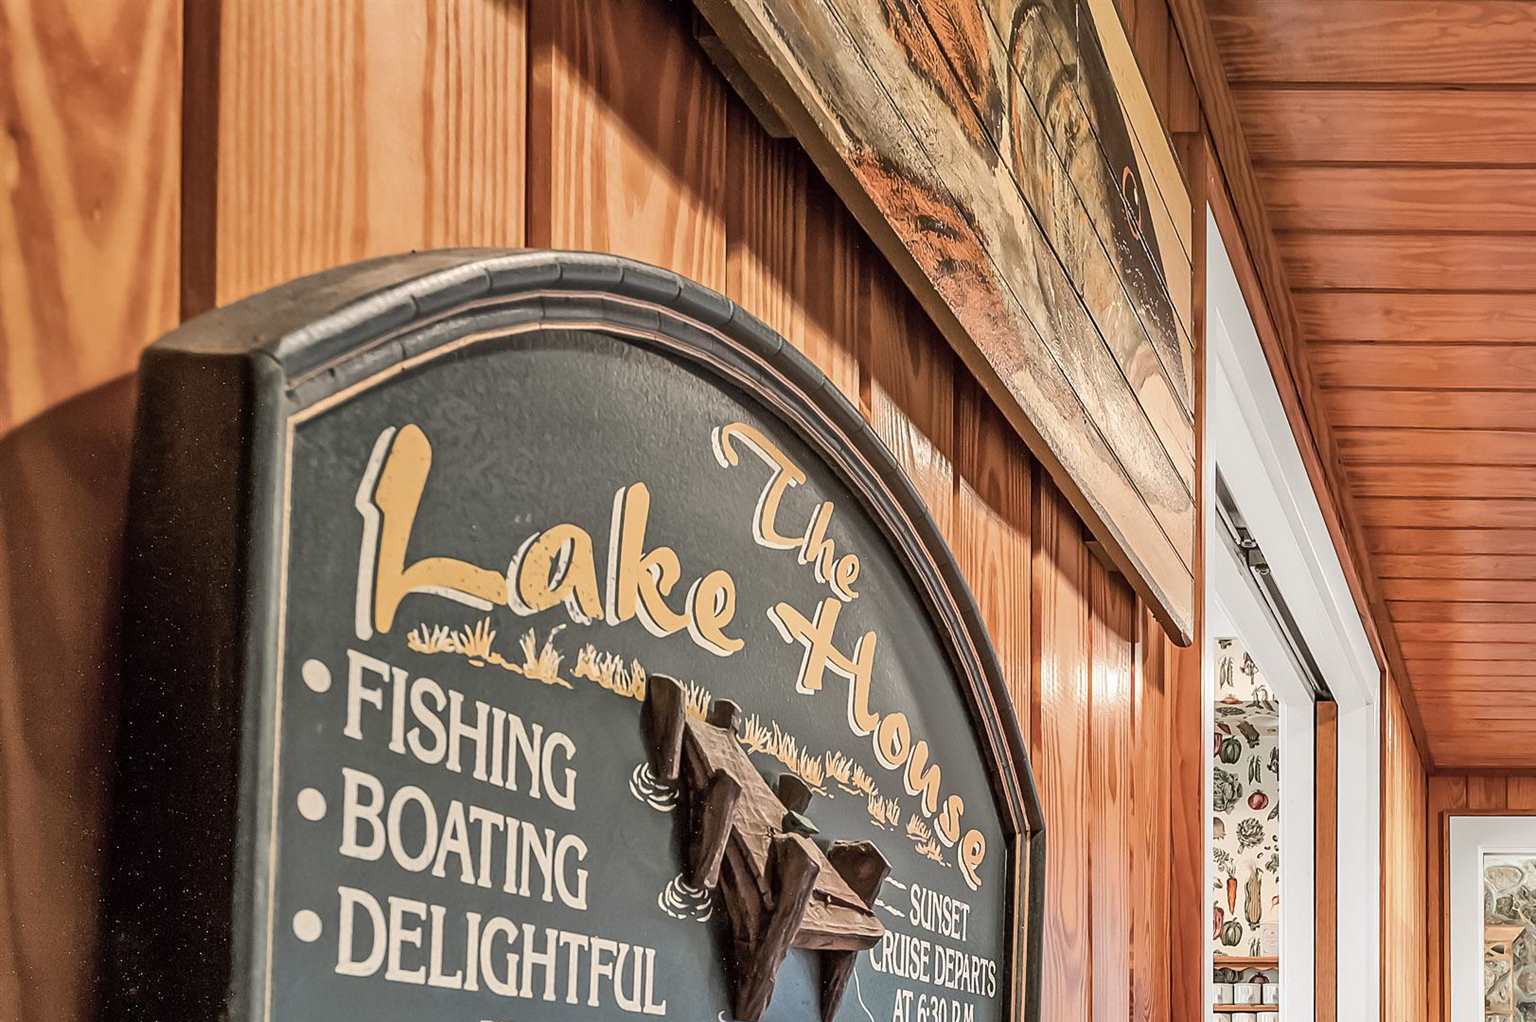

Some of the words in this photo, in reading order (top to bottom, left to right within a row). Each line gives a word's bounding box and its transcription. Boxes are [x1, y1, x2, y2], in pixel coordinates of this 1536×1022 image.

[354, 423, 746, 658] Lake
[711, 421, 860, 602] The
[343, 648, 578, 812] FISHING
[767, 597, 986, 891] House
[338, 766, 589, 910] BOATING
[909, 883, 971, 942] SUNSET
[334, 886, 667, 1017] DELIGHTFUL
[934, 945, 997, 999] DEPARTS
